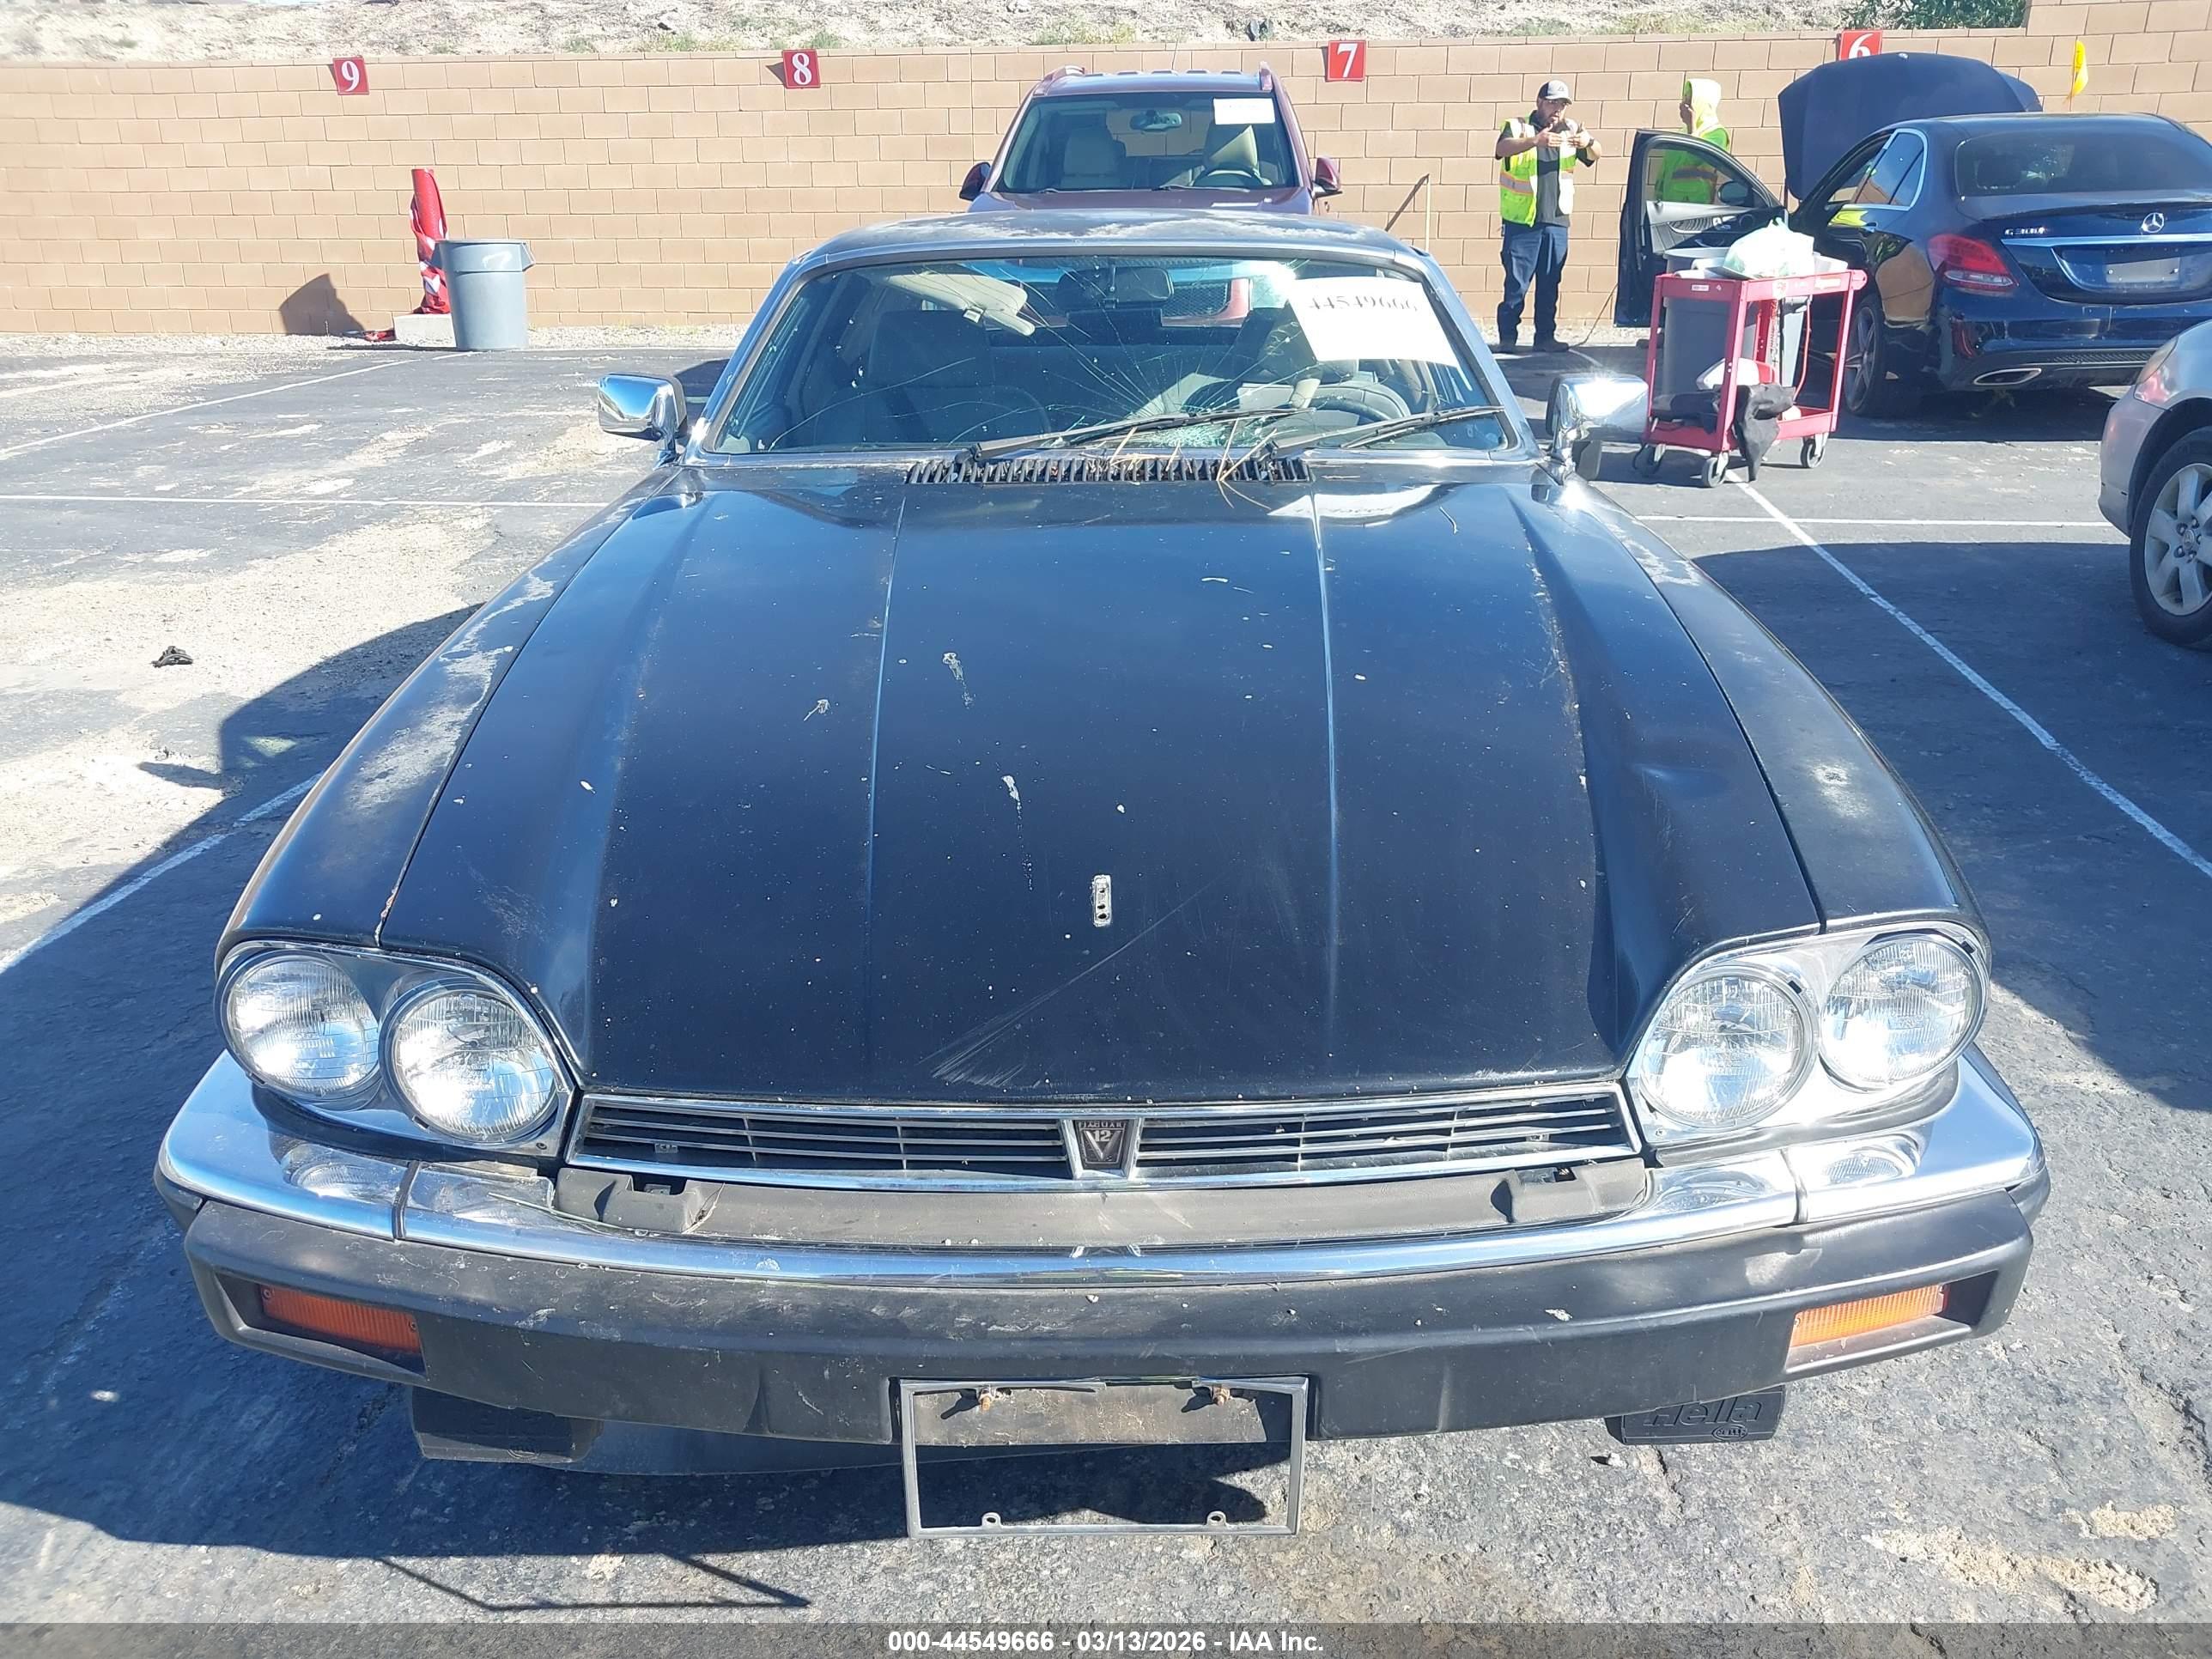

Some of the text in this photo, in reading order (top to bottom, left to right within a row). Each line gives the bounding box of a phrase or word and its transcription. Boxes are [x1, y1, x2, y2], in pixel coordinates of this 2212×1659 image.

[1337, 43, 1358, 78] 7
[1848, 33, 1874, 59] 6
[341, 60, 360, 92] 9
[792, 52, 812, 85] 8
